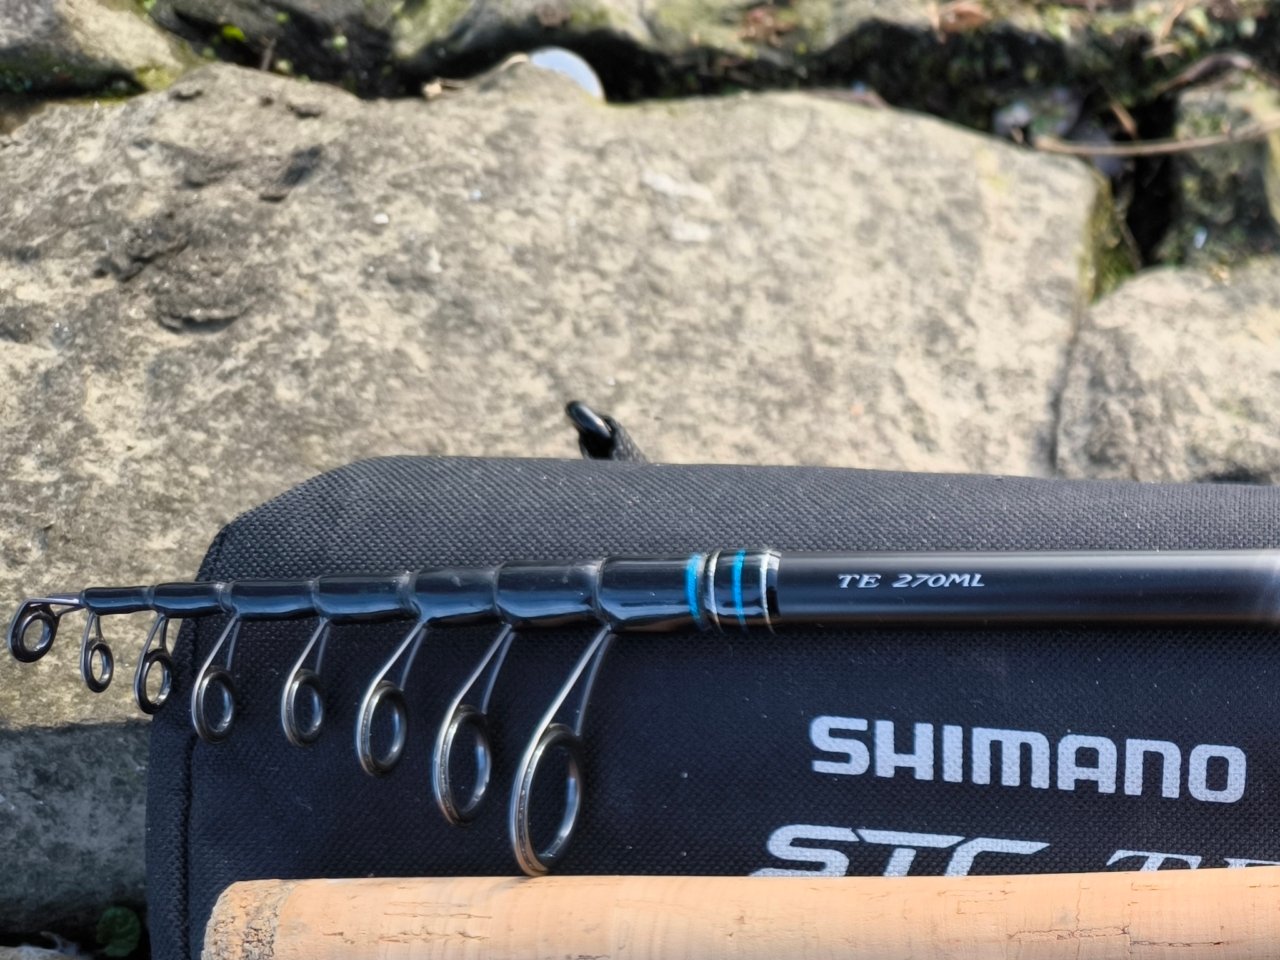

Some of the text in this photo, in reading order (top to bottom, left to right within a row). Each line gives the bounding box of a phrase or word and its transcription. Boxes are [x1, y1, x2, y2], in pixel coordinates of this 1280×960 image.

[838, 573, 986, 589] TE 270ML
[809, 715, 1248, 804] SHIMANO
